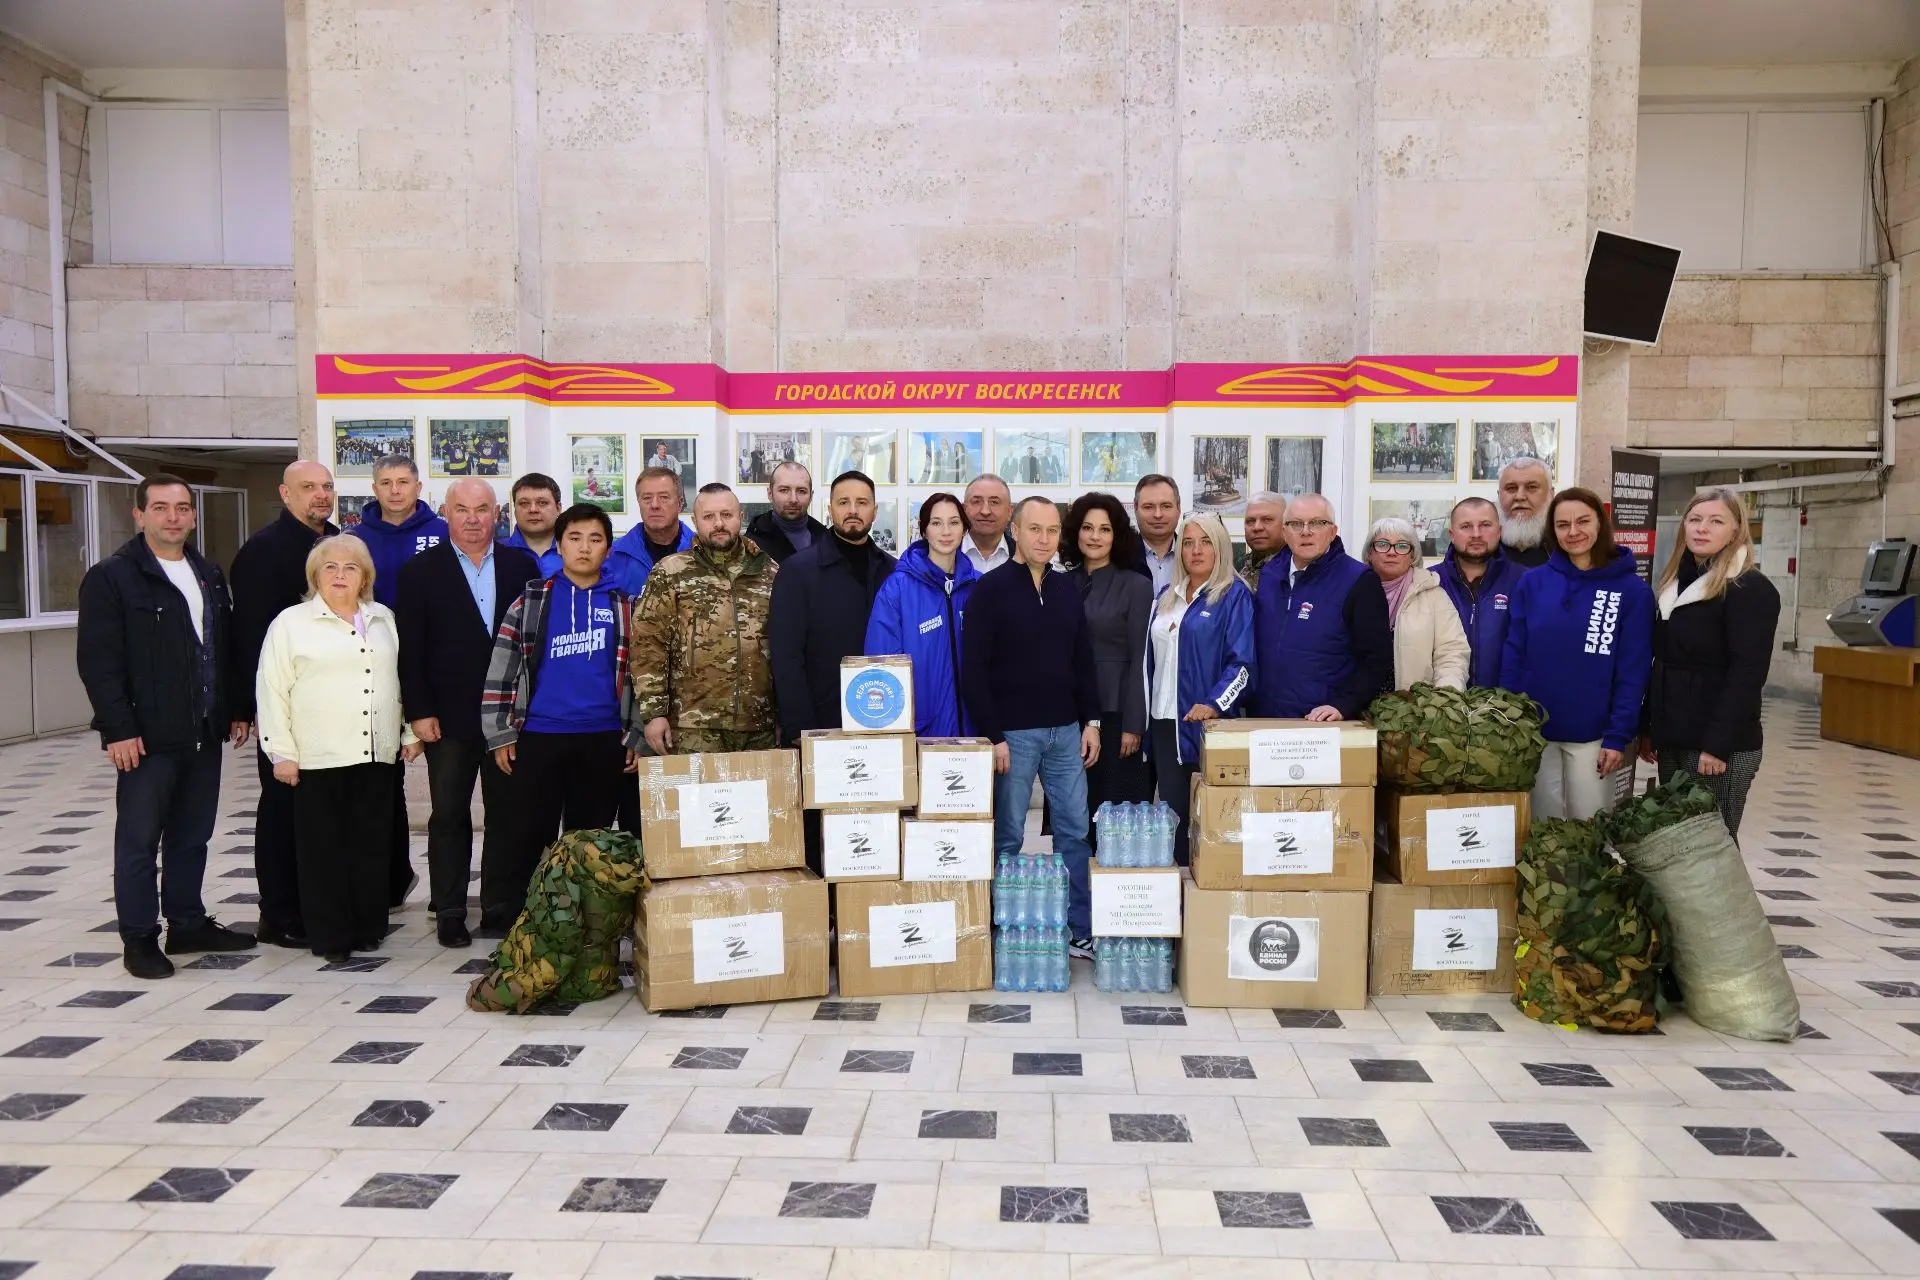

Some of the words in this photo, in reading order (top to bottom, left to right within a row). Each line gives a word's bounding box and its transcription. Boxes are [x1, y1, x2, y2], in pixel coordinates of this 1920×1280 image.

[775, 380, 897, 401] ГОРОДСКОЙ
[902, 383, 970, 400] ОКРУГ
[975, 383, 1123, 400] ВОСКРЕСЕНСК
[1584, 590, 1608, 653] ЕДИНАЯ
[1599, 592, 1622, 655] РОССИЯ
